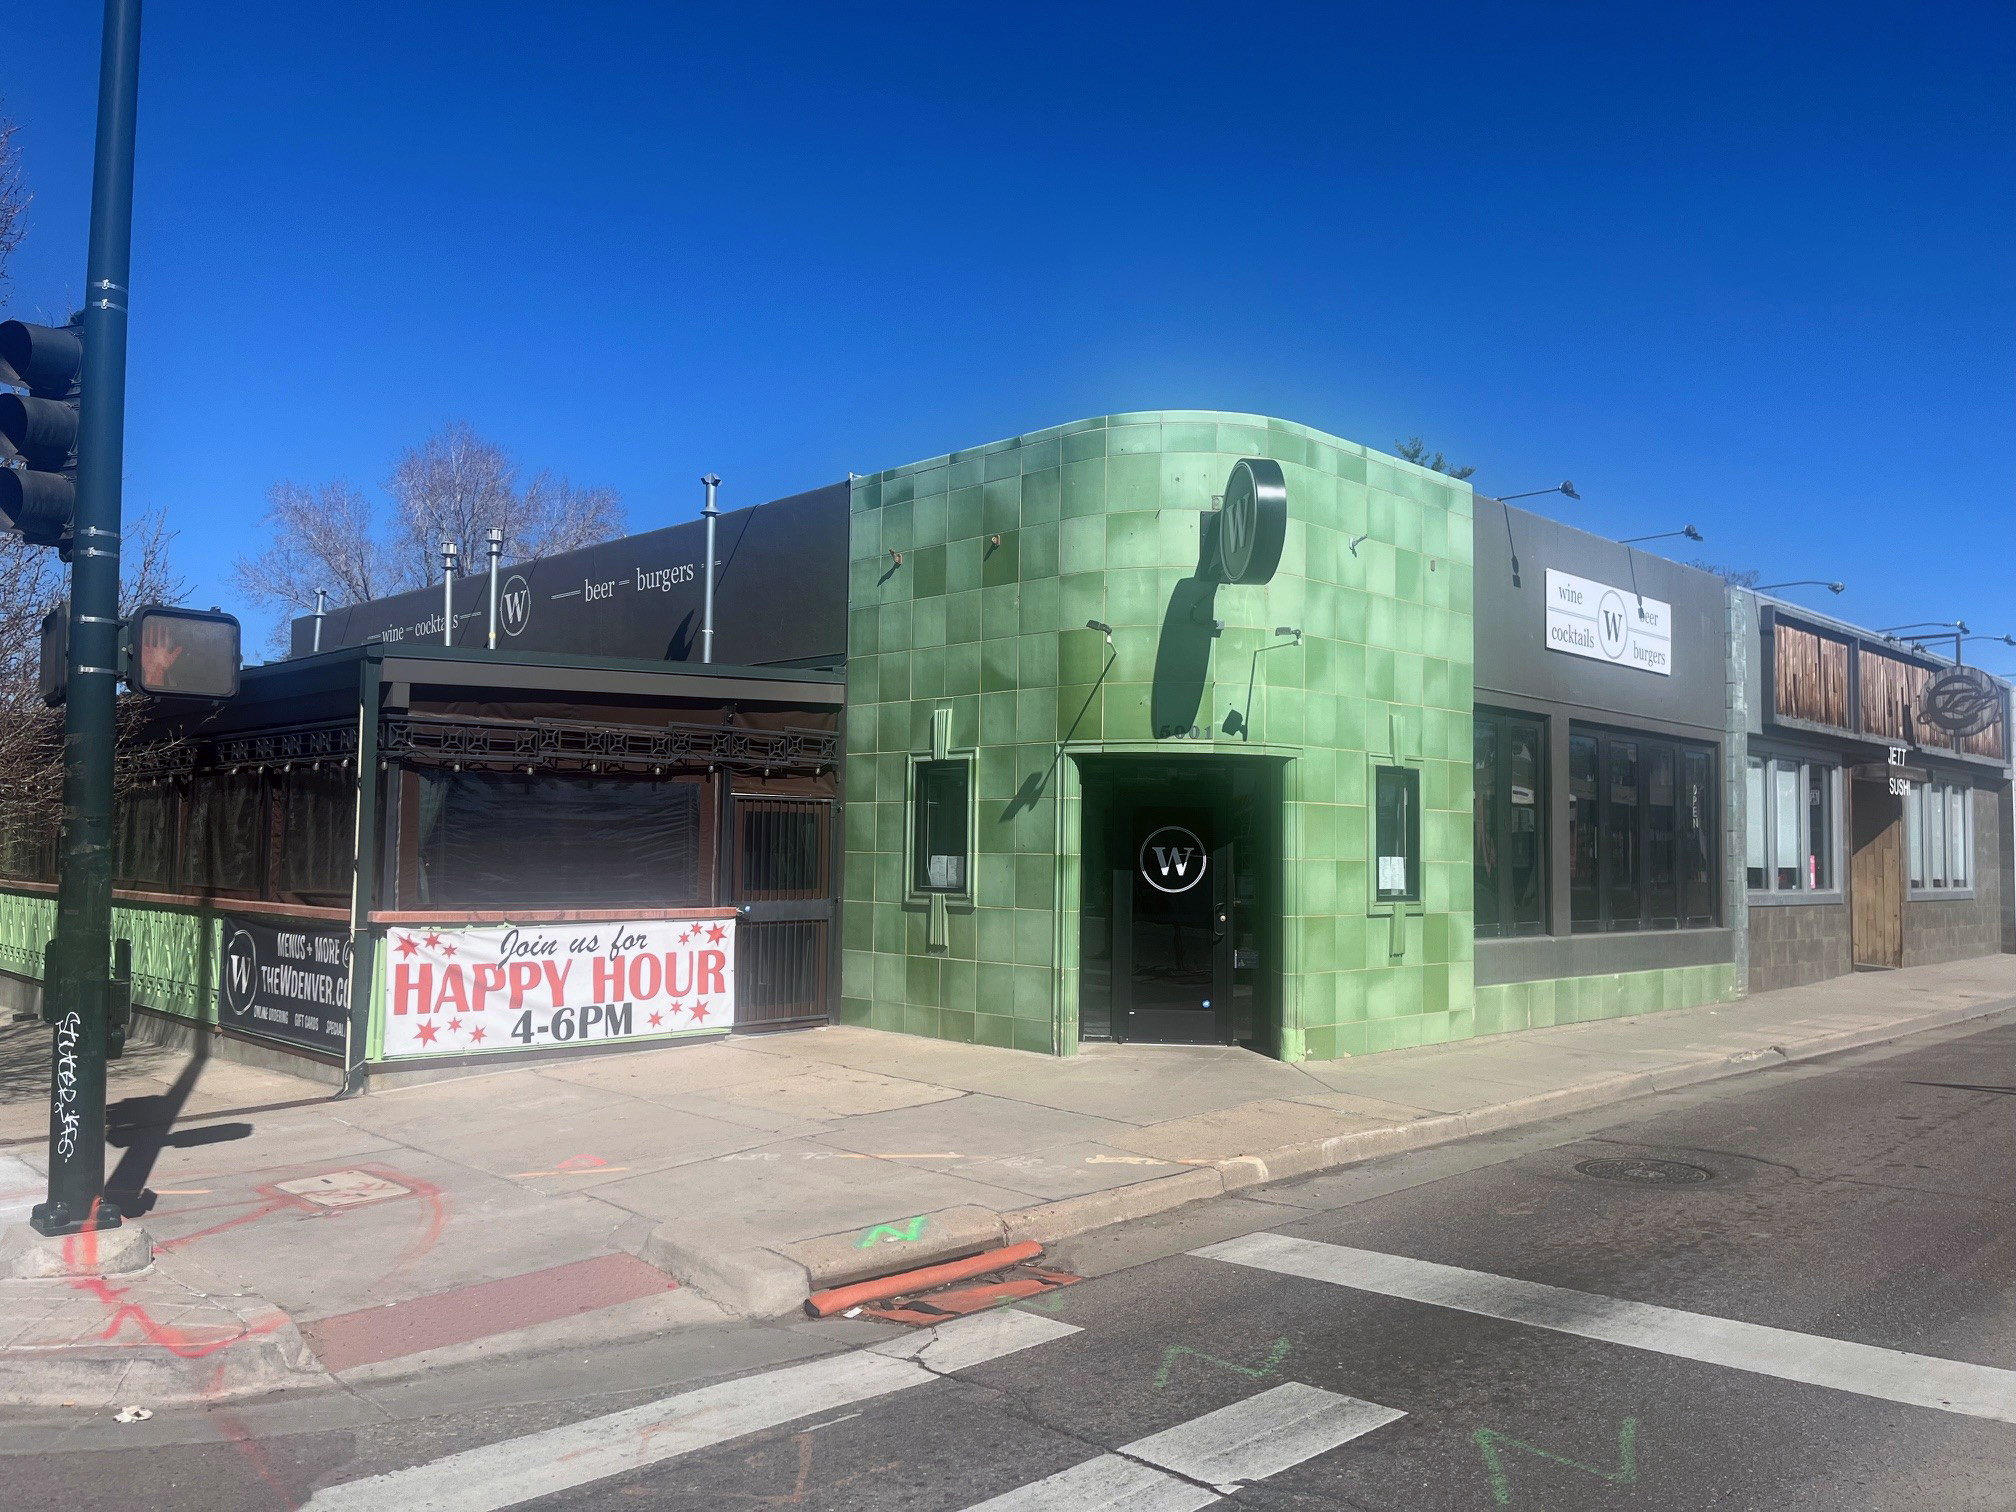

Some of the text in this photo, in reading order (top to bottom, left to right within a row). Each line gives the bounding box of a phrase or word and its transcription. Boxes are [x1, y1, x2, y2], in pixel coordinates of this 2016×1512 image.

[1226, 491, 1251, 554] W
[381, 562, 694, 643] wine cocktas W beer burgers
[1558, 583, 1583, 605] wine
[1602, 609, 1623, 643] W
[1551, 624, 1666, 667] cocktails burgers
[1160, 725, 1213, 739] 5001
[1887, 746, 1907, 766] JETT
[1889, 777, 1911, 796] SUSHI
[1151, 846, 1195, 877] W
[277, 932, 306, 960] MENUS
[315, 936, 340, 965] MORE
[498, 925, 648, 970] Join us for
[231, 954, 251, 994] W
[393, 949, 726, 1016] HAPPY HOUR
[294, 1013, 304, 1028] GIFT
[325, 1020, 346, 1038] SPECIAL
[511, 1002, 632, 1044] 4-6PM
